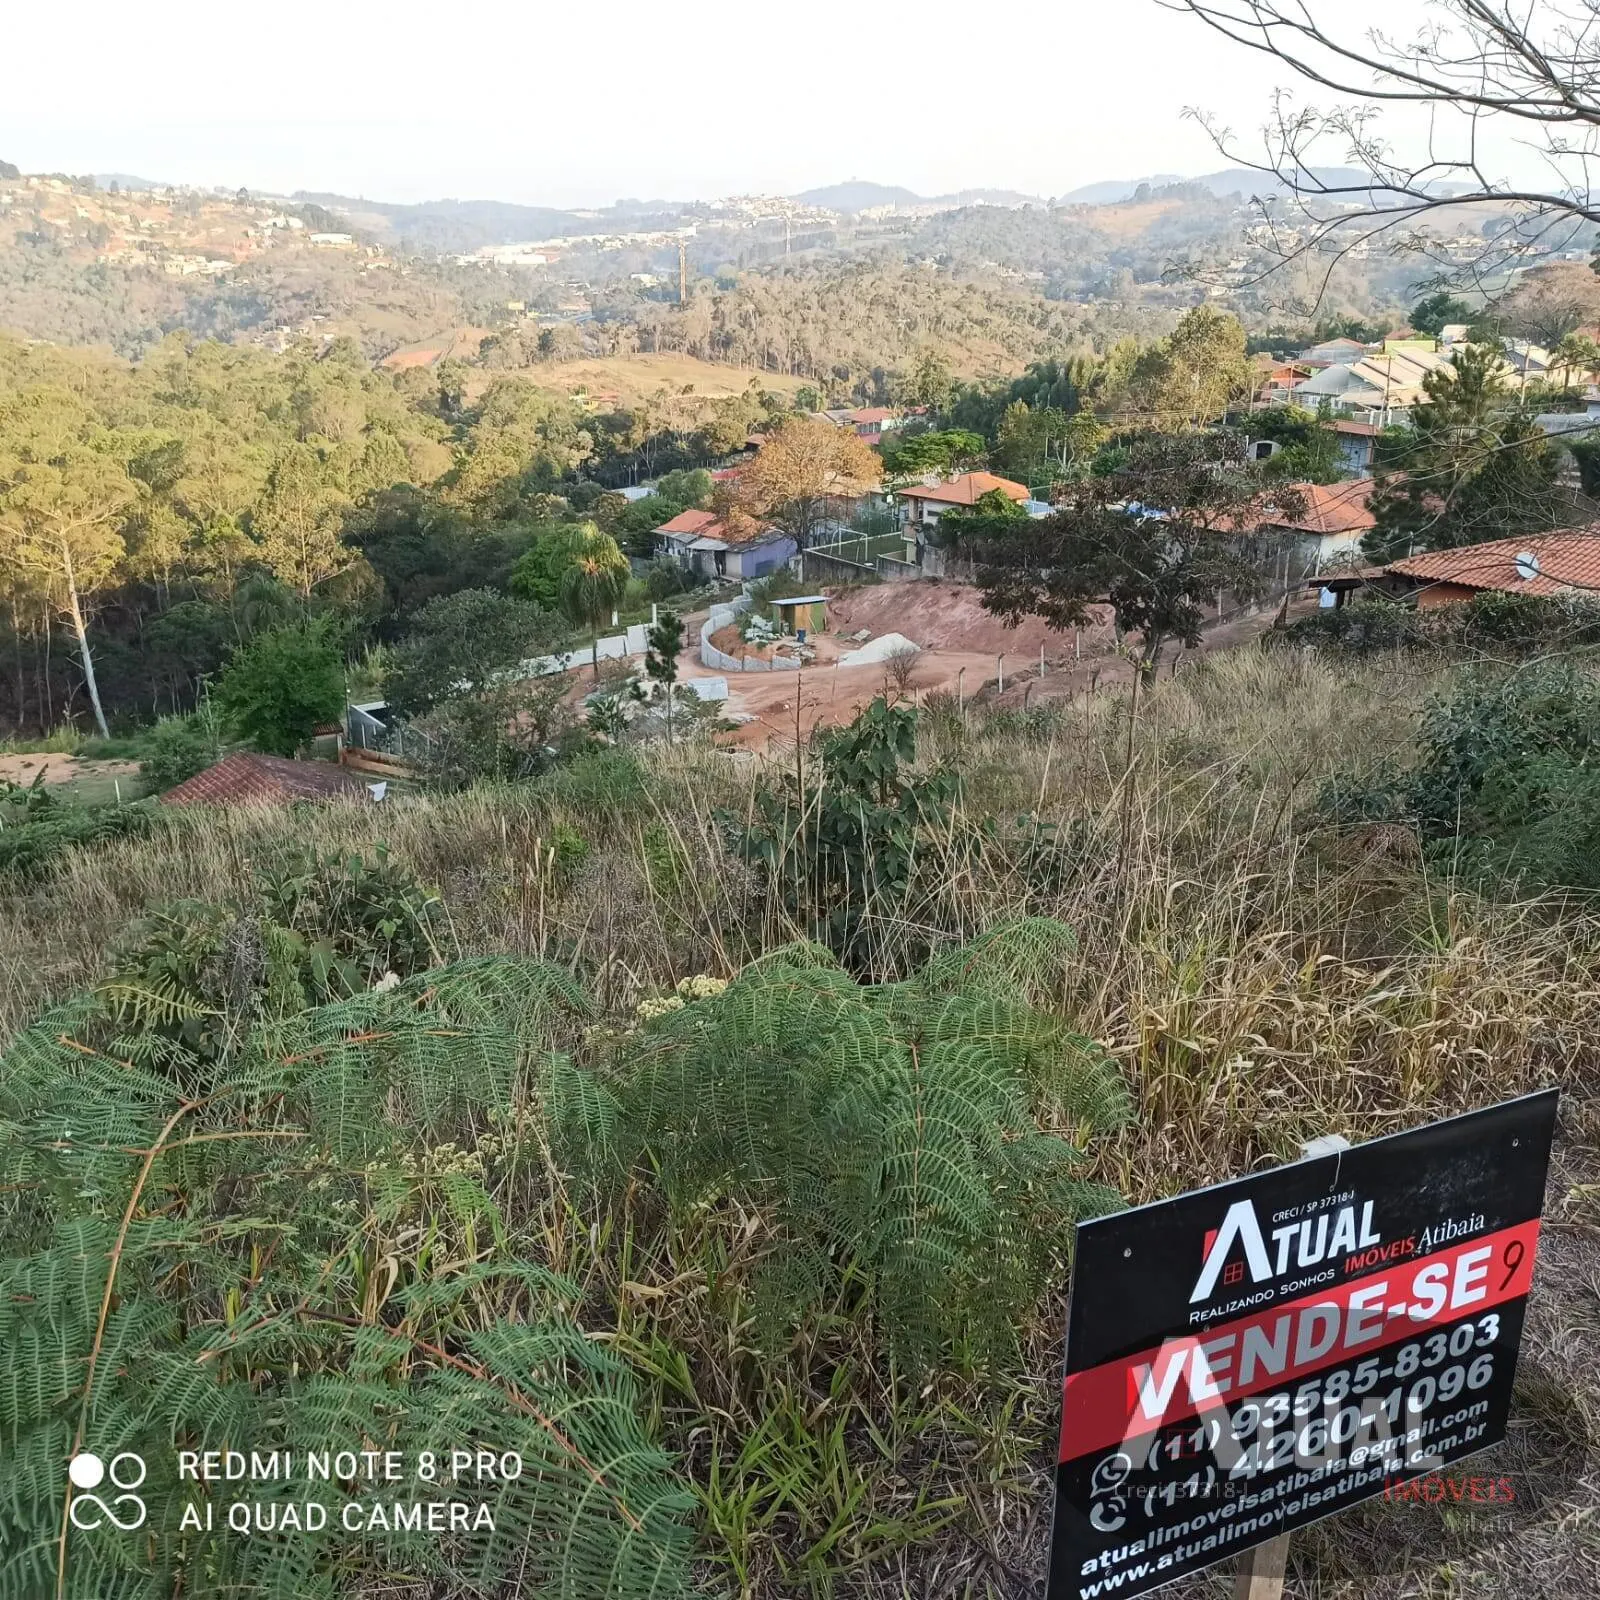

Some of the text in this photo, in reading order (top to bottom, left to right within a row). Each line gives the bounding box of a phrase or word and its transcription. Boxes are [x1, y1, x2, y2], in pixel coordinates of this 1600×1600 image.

[1189, 1199, 1381, 1304] ATUAL
[1272, 1206, 1299, 1223] CRECI
[1306, 1201, 1318, 1213] SP
[1319, 1190, 1355, 1209] 37318-J
[1279, 1268, 1336, 1295] SONHOS
[1417, 1212, 1485, 1250] Atibaia
[1132, 1245, 1492, 1420] VENDE-SE
[1149, 1313, 1500, 1472] (11) 93585-8303
[1079, 1422, 1487, 1600] www.atualimoveisatibaia.com.br
[1080, 1400, 1489, 1576] atualimoveisatibaia@gmail.com
[1144, 1353, 1494, 1518] (11) 4260-1096
